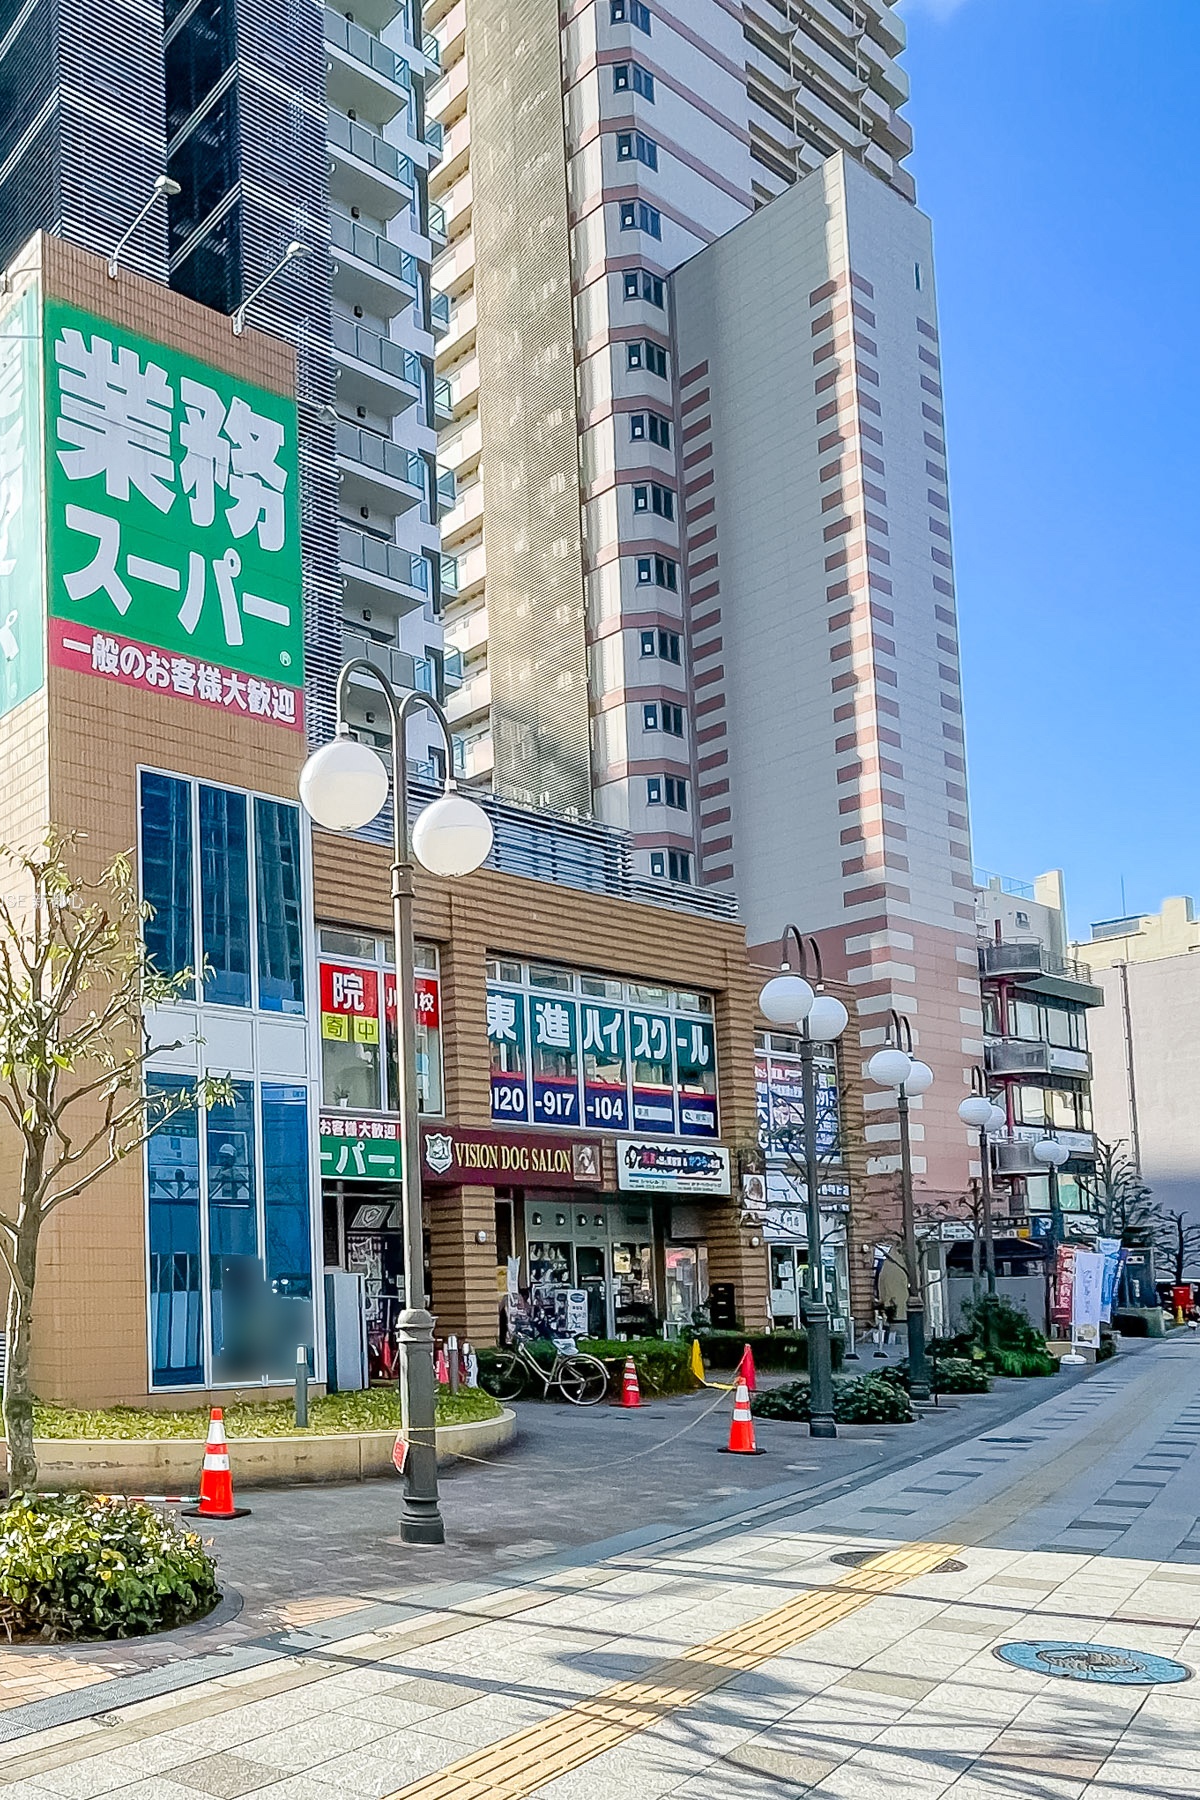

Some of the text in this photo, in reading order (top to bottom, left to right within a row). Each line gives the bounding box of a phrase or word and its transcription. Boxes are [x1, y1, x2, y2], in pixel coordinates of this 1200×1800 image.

[54, 326, 289, 551] 業務
[63, 503, 291, 646] スーパー
[62, 635, 296, 723] 一般のお客様大歓迎
[332, 971, 365, 1011] 院
[320, 1119, 397, 1140] お客様大歓迎
[454, 1142, 572, 1173] VISION DOG SALON
